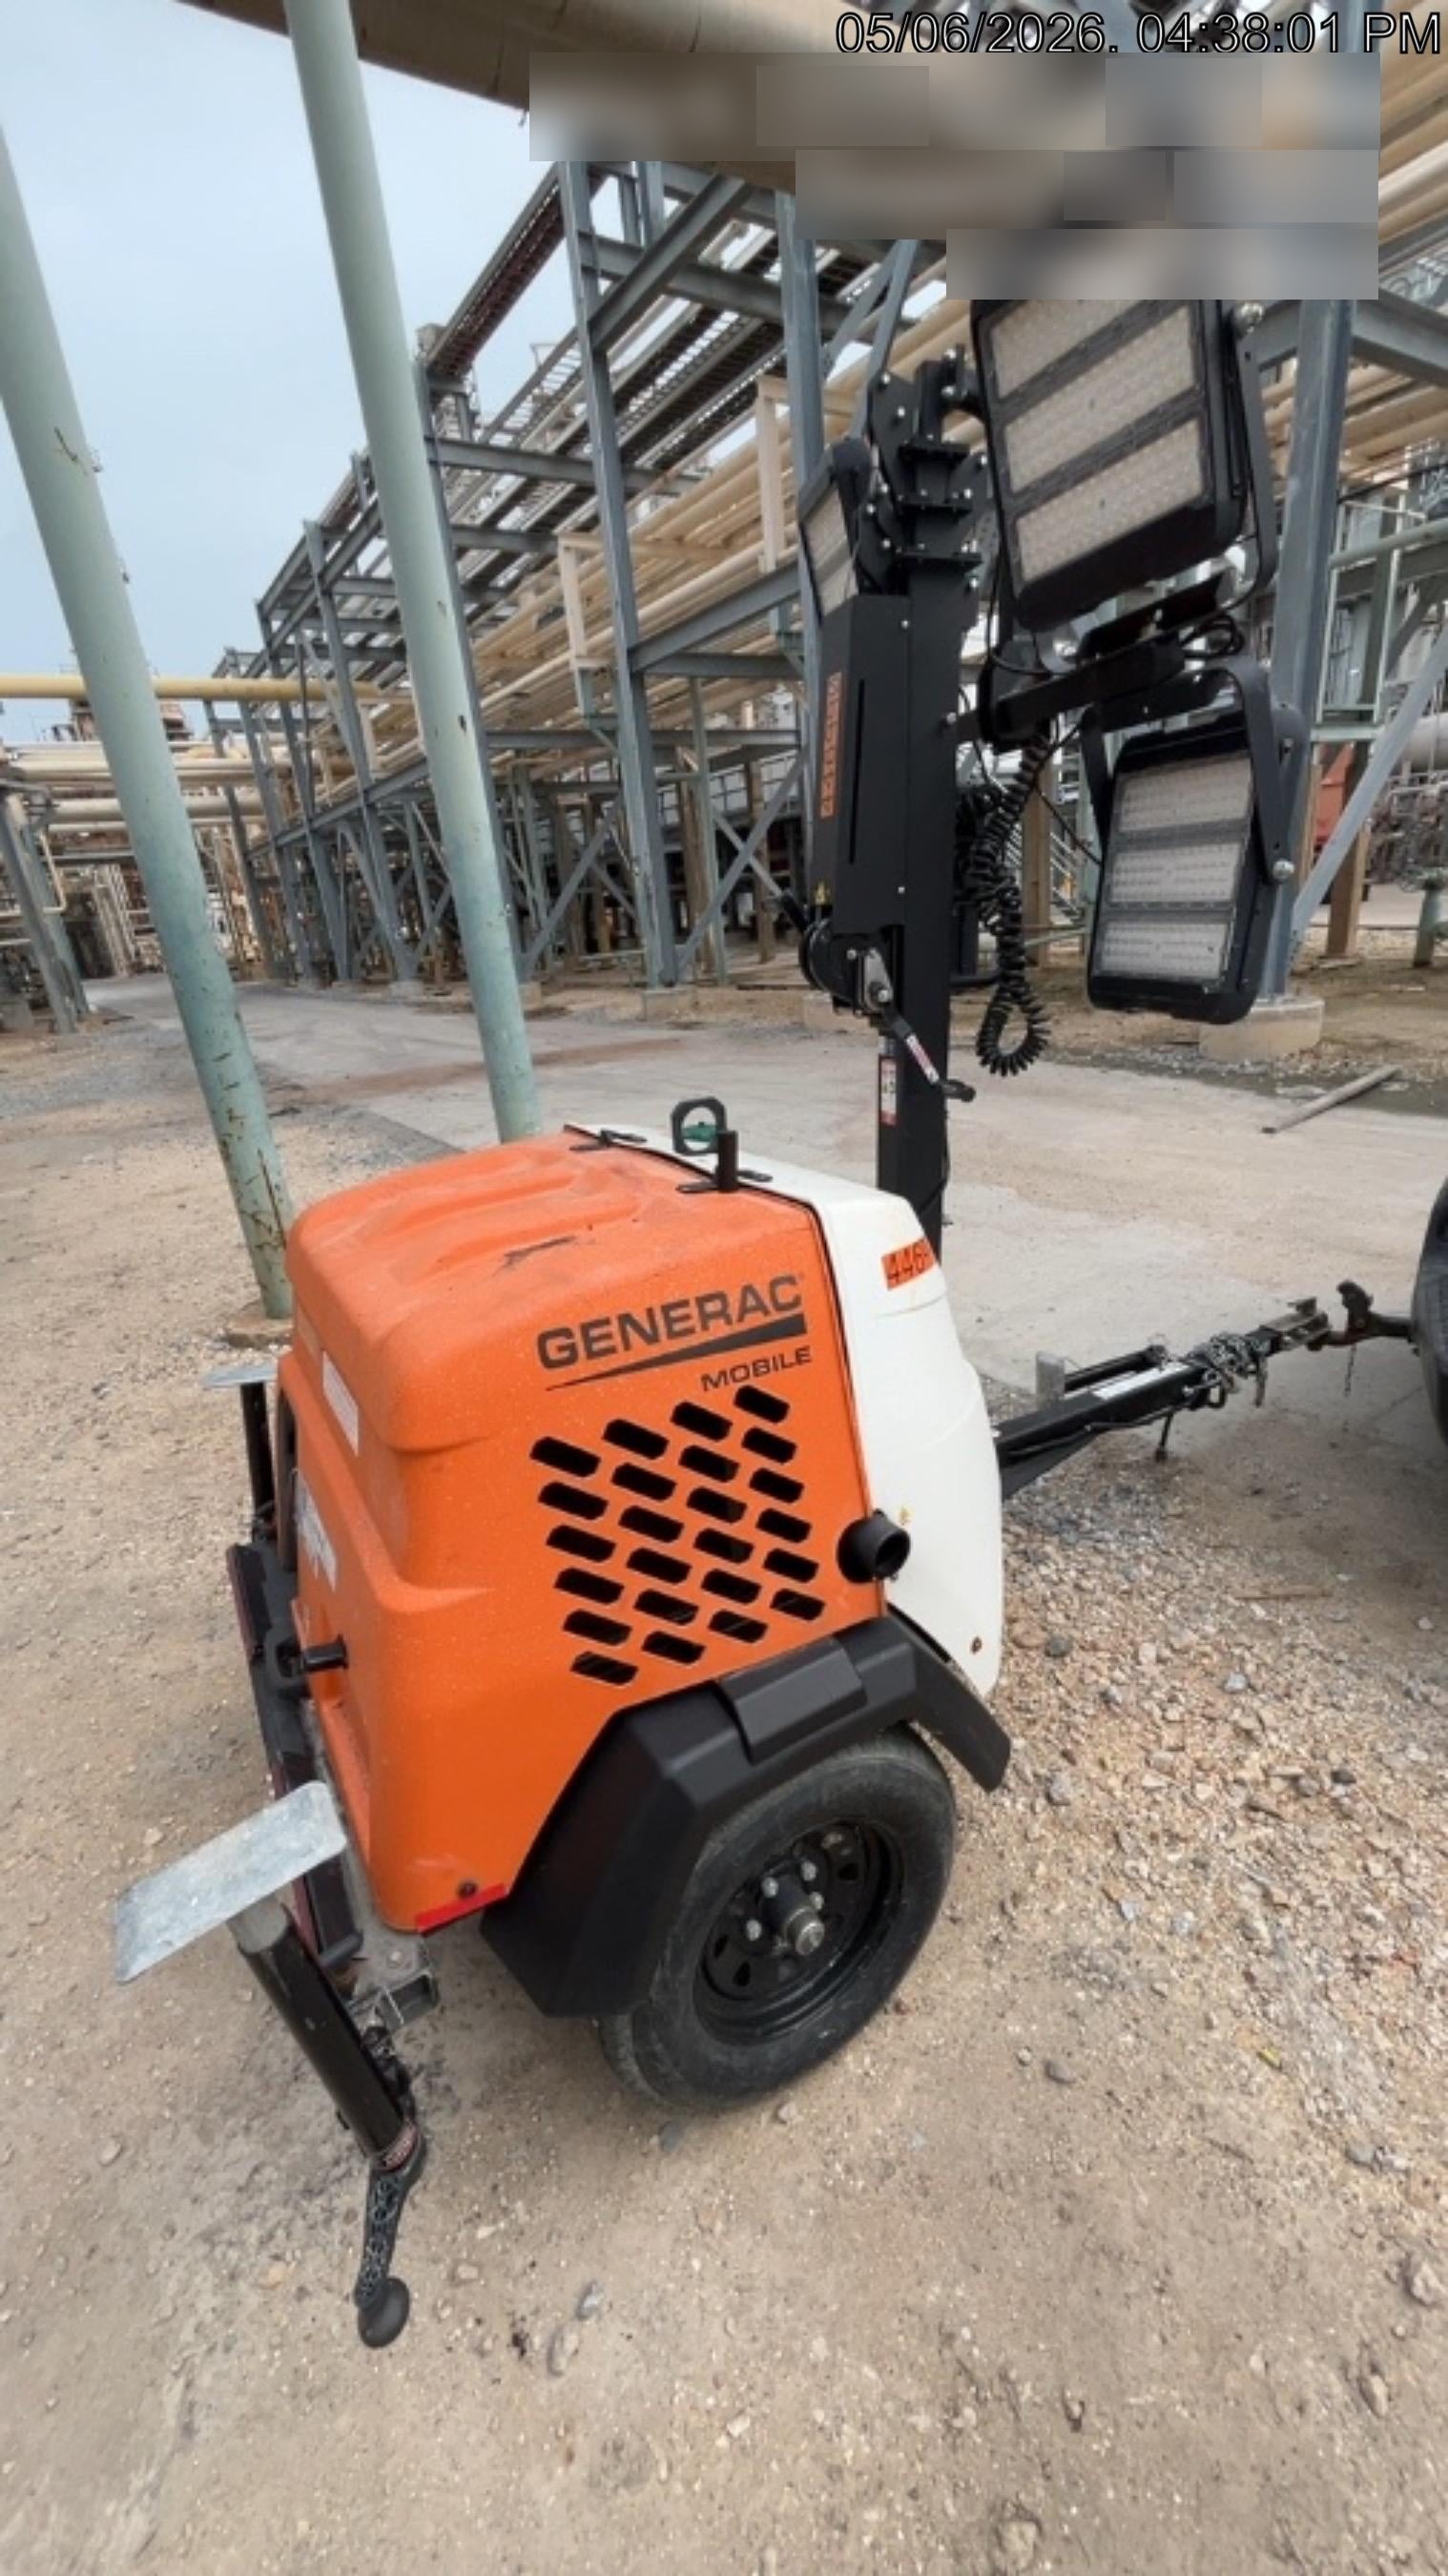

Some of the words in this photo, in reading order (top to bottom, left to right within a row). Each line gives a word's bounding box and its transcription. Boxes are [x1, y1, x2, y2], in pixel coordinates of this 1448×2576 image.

[881, 1239, 935, 1288] 446
[537, 1273, 803, 1369] GENERAC
[700, 1345, 813, 1392] MOBILE
